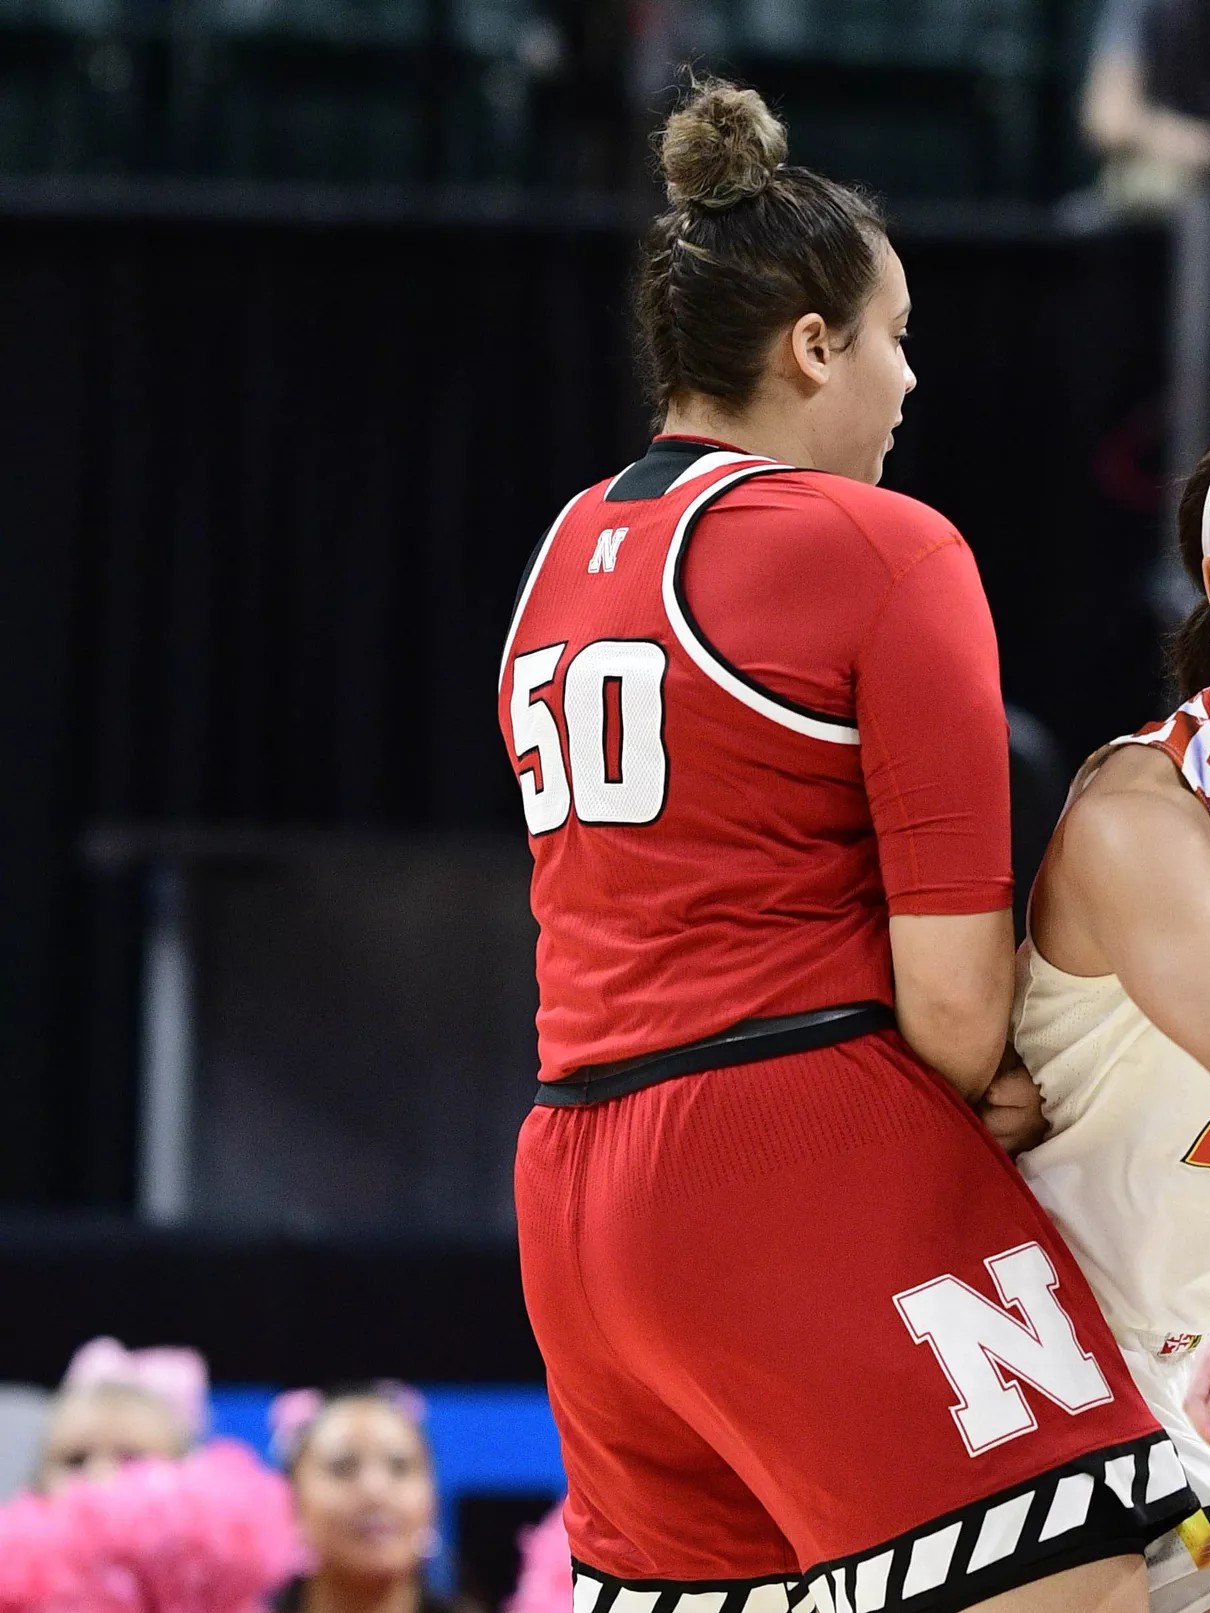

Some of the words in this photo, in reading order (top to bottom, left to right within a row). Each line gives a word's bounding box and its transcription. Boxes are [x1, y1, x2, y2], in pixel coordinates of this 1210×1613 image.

[587, 527, 629, 573] N
[509, 639, 668, 837] 50
[892, 1241, 1115, 1458] N
